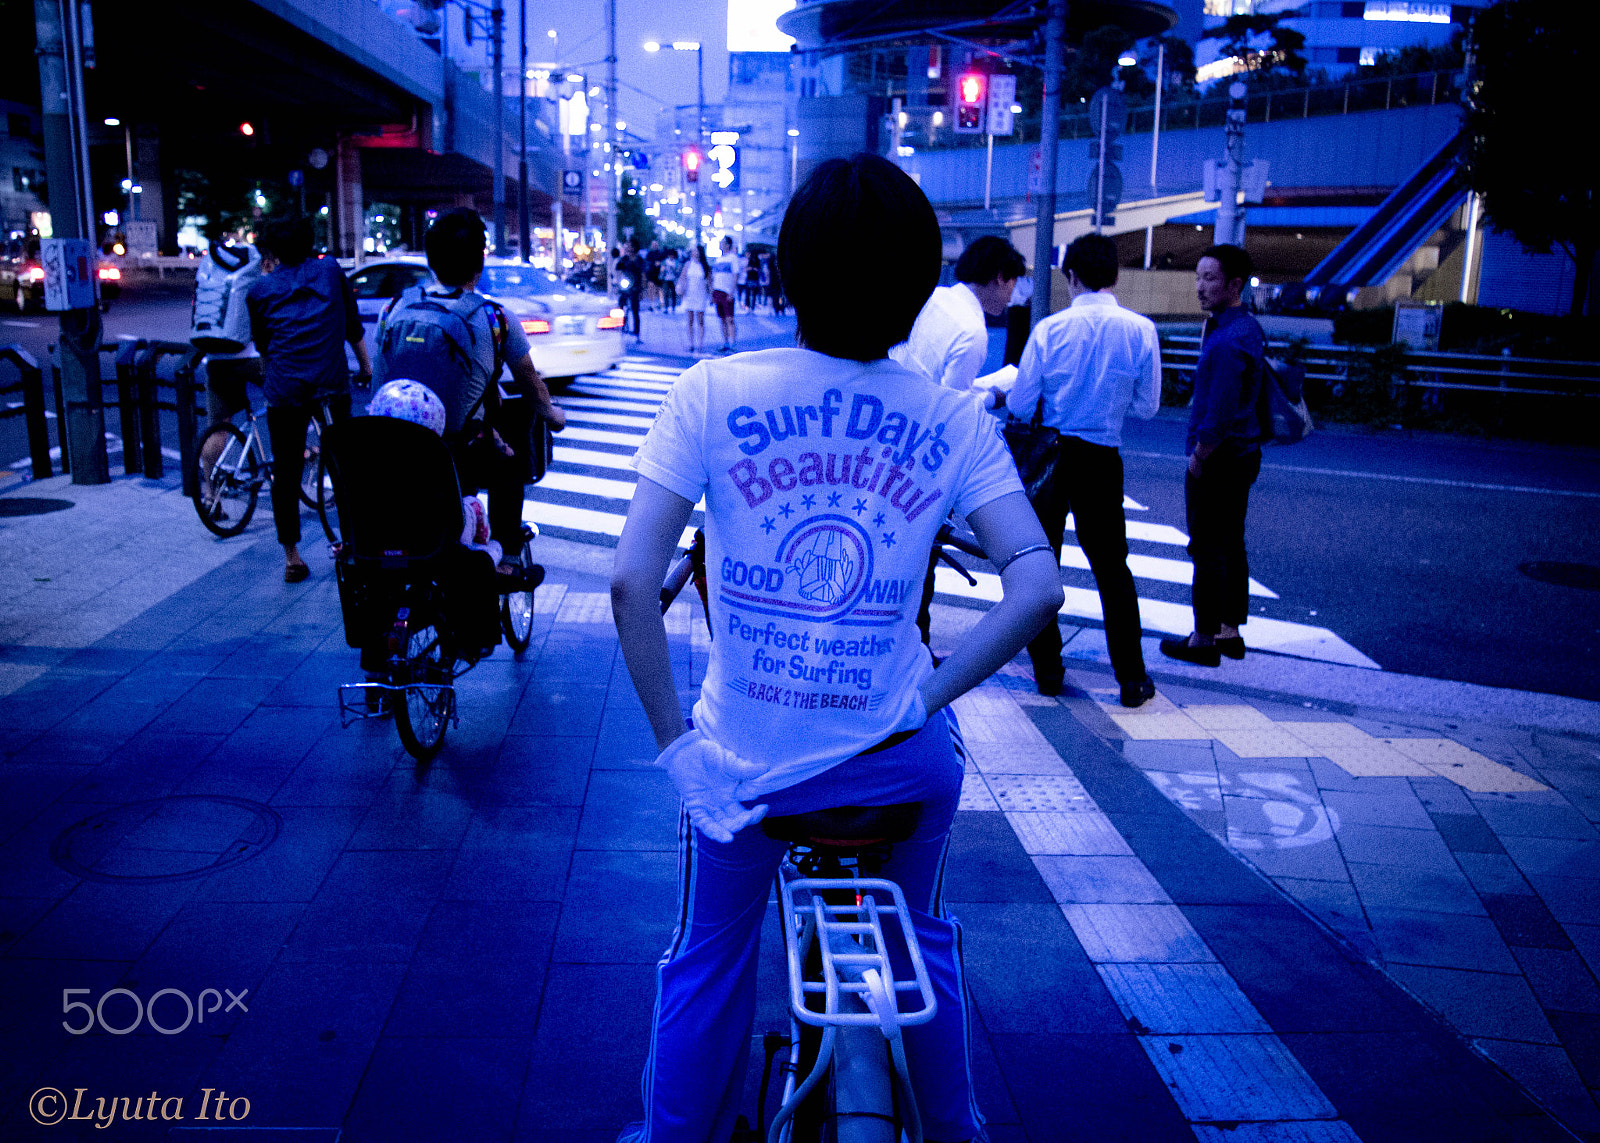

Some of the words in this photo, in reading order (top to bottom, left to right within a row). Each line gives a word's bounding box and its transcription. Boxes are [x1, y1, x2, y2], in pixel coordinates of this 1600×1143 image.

[726, 387, 843, 456] Surf
[845, 392, 950, 473] Day's
[727, 446, 944, 524] Beautiful
[720, 556, 785, 593] GOOD
[728, 613, 811, 653] Perfect
[814, 633, 896, 657] weathr
[752, 648, 786, 675] for
[788, 655, 873, 691] Surfing
[747, 681, 783, 704] BACK
[782, 689, 792, 707] 2
[793, 691, 819, 710] THE
[819, 693, 869, 712] BEACH
